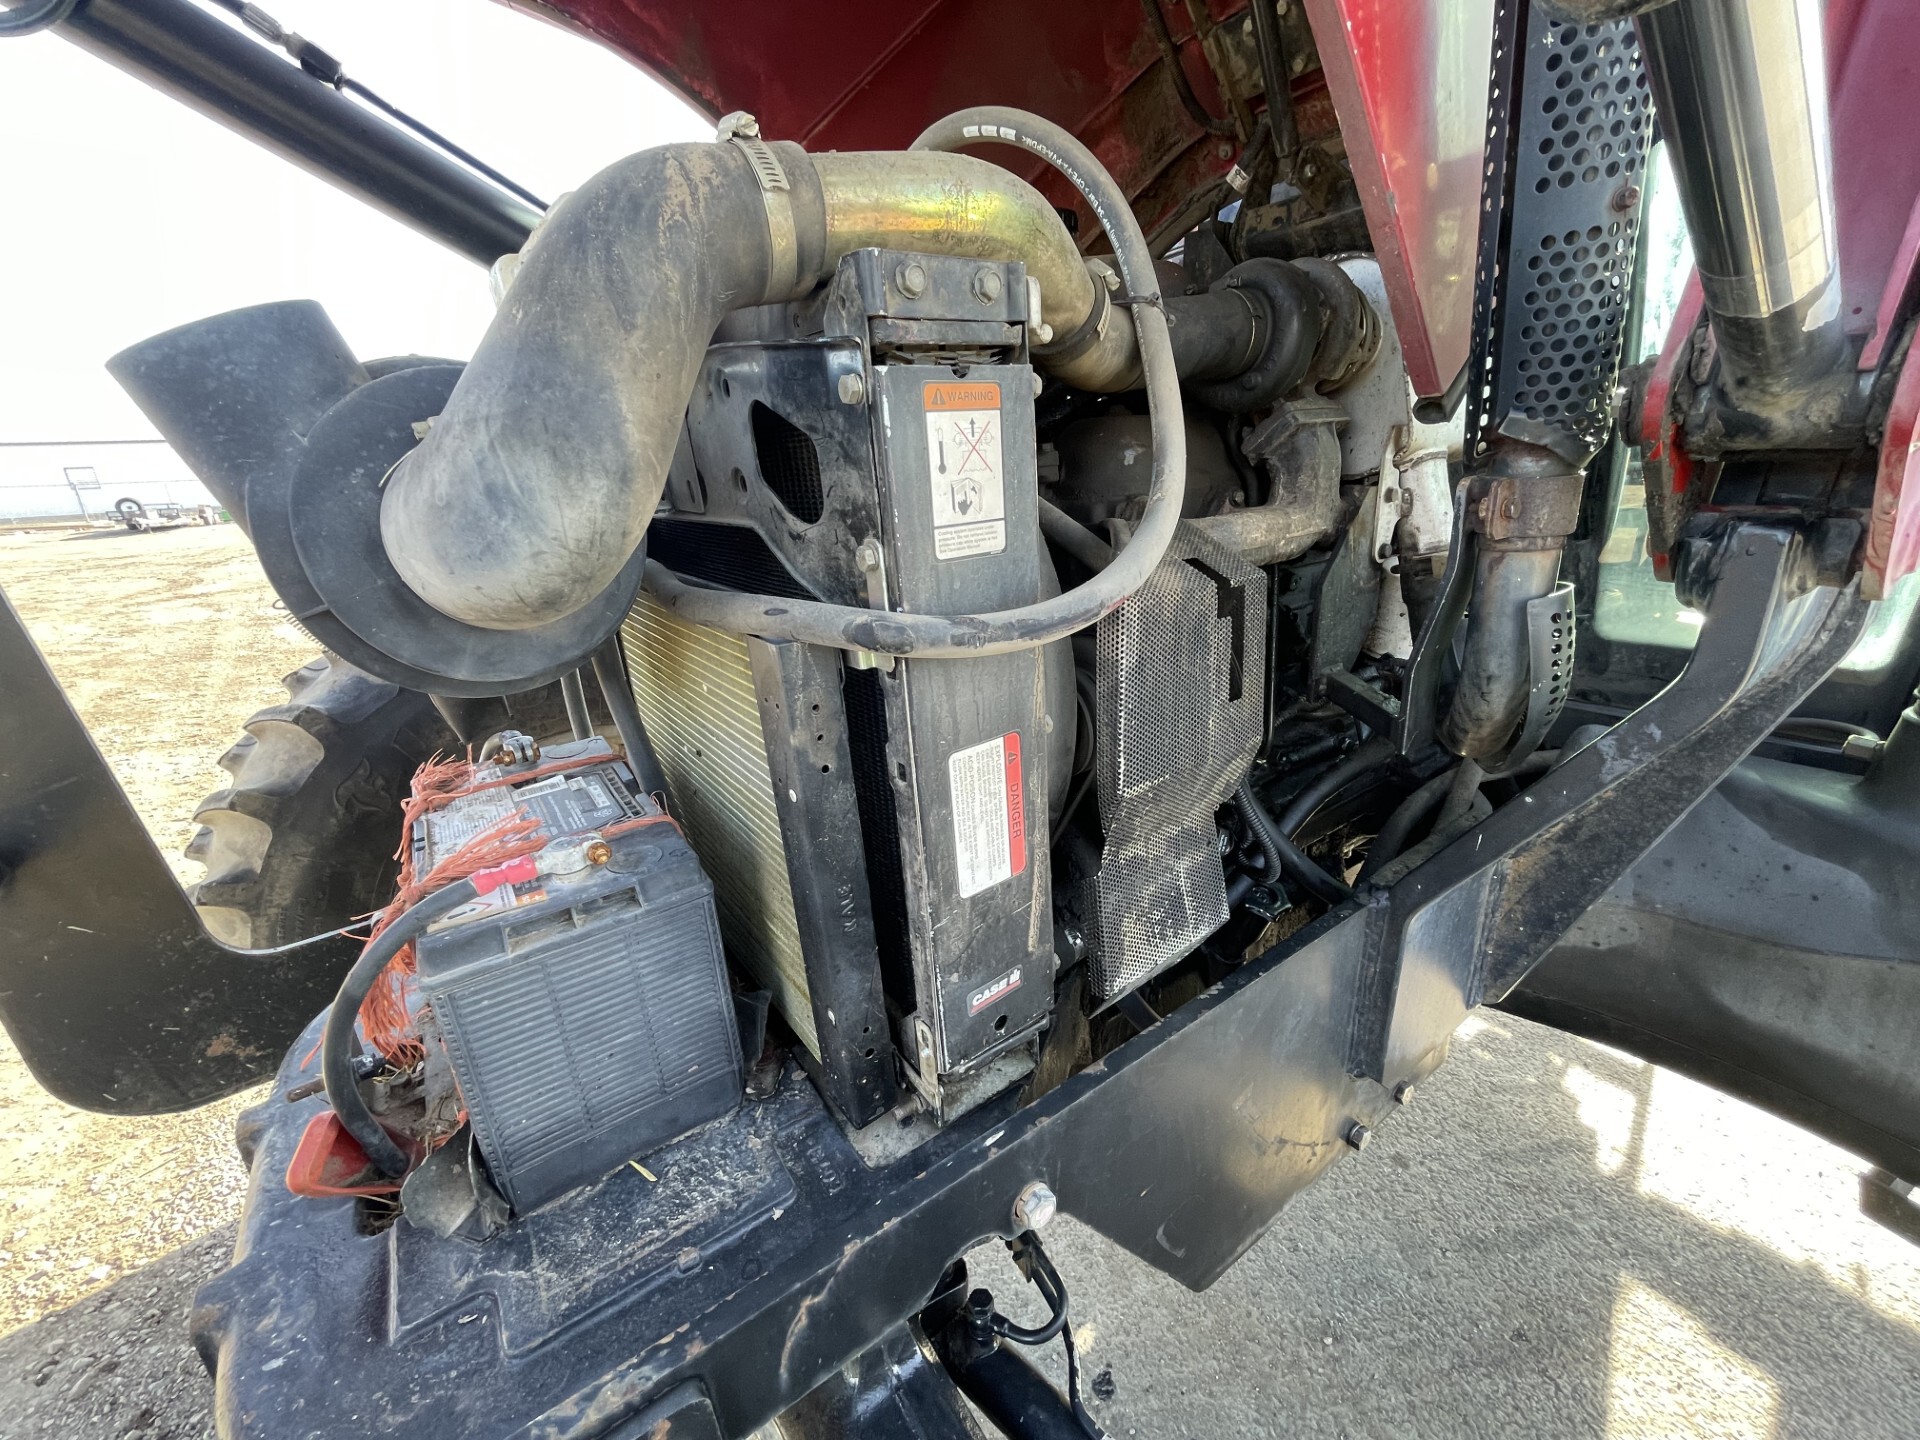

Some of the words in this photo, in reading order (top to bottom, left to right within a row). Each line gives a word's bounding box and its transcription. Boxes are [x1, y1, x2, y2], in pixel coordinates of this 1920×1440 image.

[1097, 206, 1105, 218] 34
[948, 391, 994, 402] WARNING
[995, 745, 1003, 785] EXPLOSIVE
[1010, 782, 1021, 839] DANGER
[973, 978, 1008, 1006] CASE
